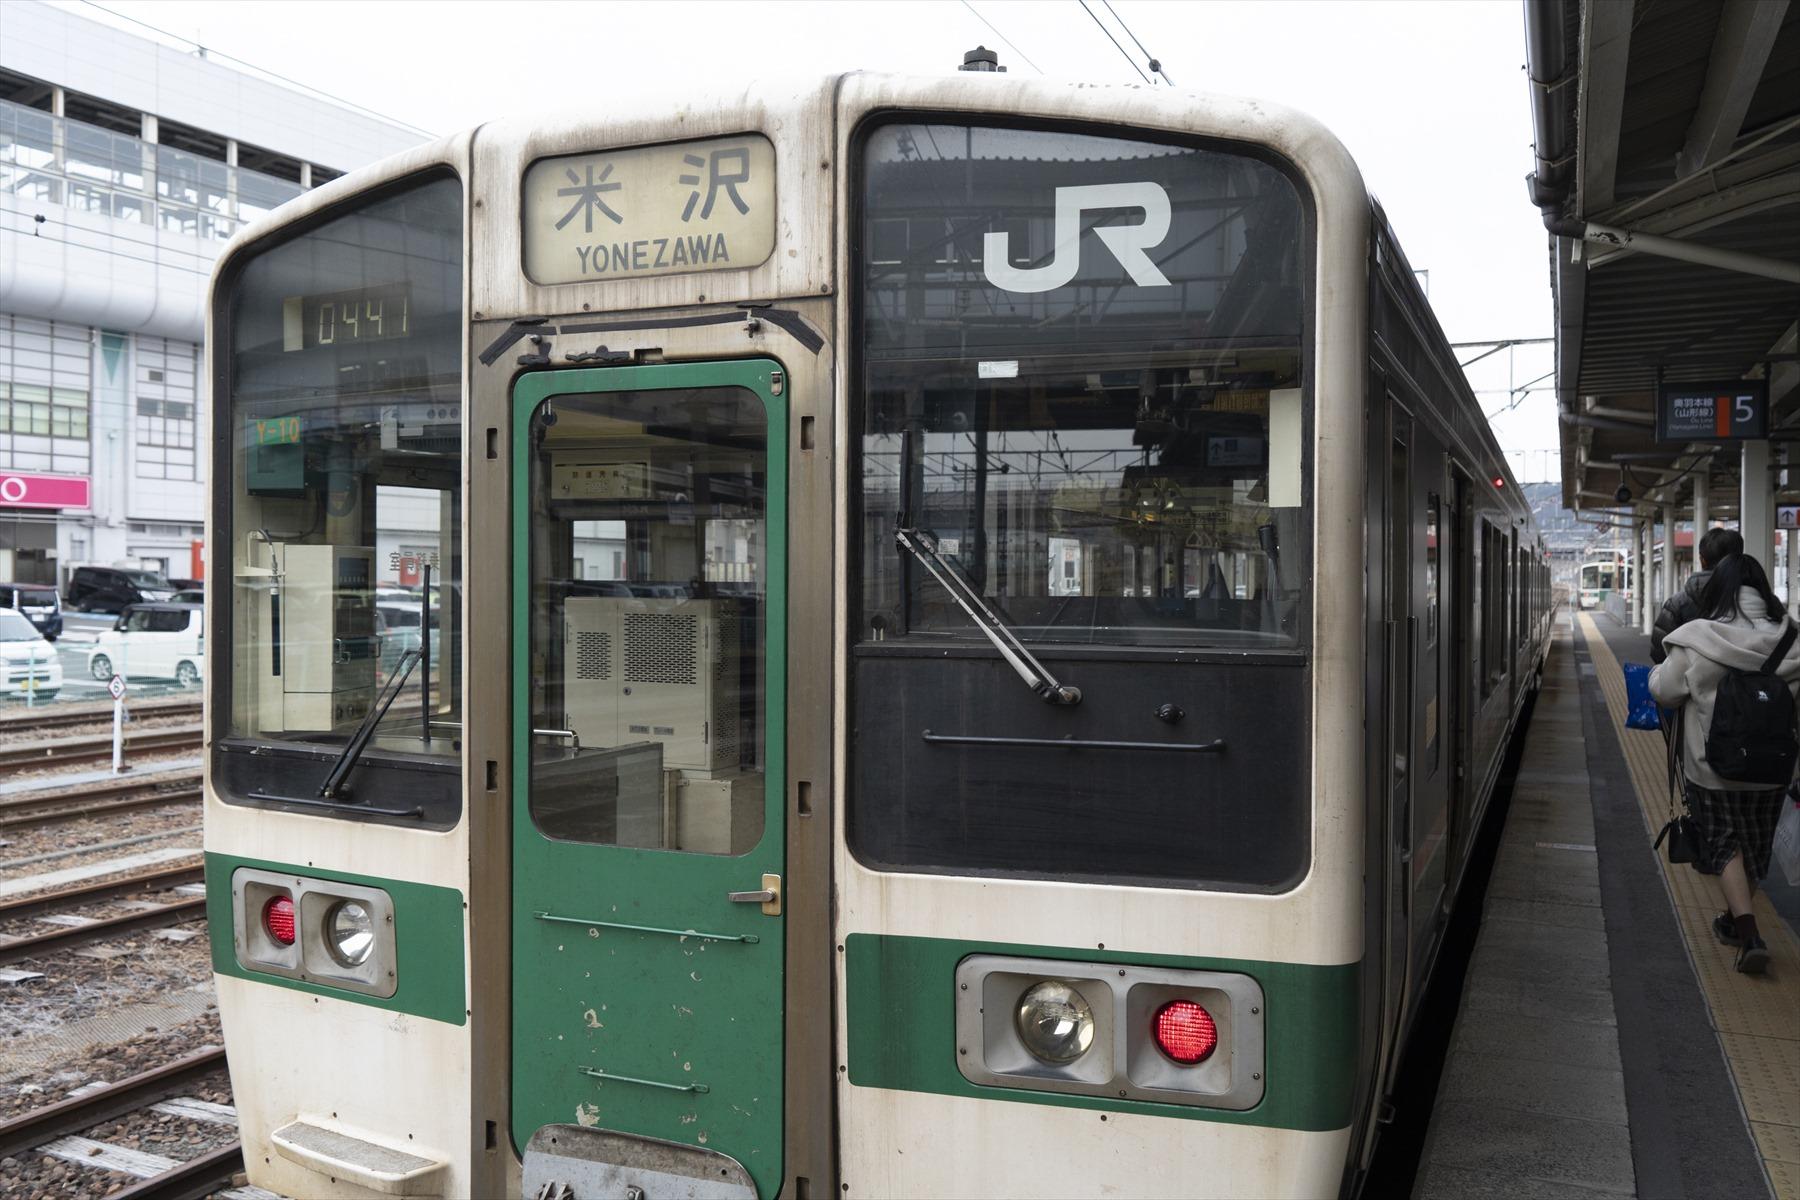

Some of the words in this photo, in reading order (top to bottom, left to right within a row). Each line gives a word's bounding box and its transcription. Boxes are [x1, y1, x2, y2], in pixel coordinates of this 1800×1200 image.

[555, 147, 750, 233] 米沢
[576, 232, 729, 274] YONEZAWA
[983, 181, 1172, 293] JR
[1735, 396, 1754, 422] 5
[257, 417, 300, 444] Y-10
